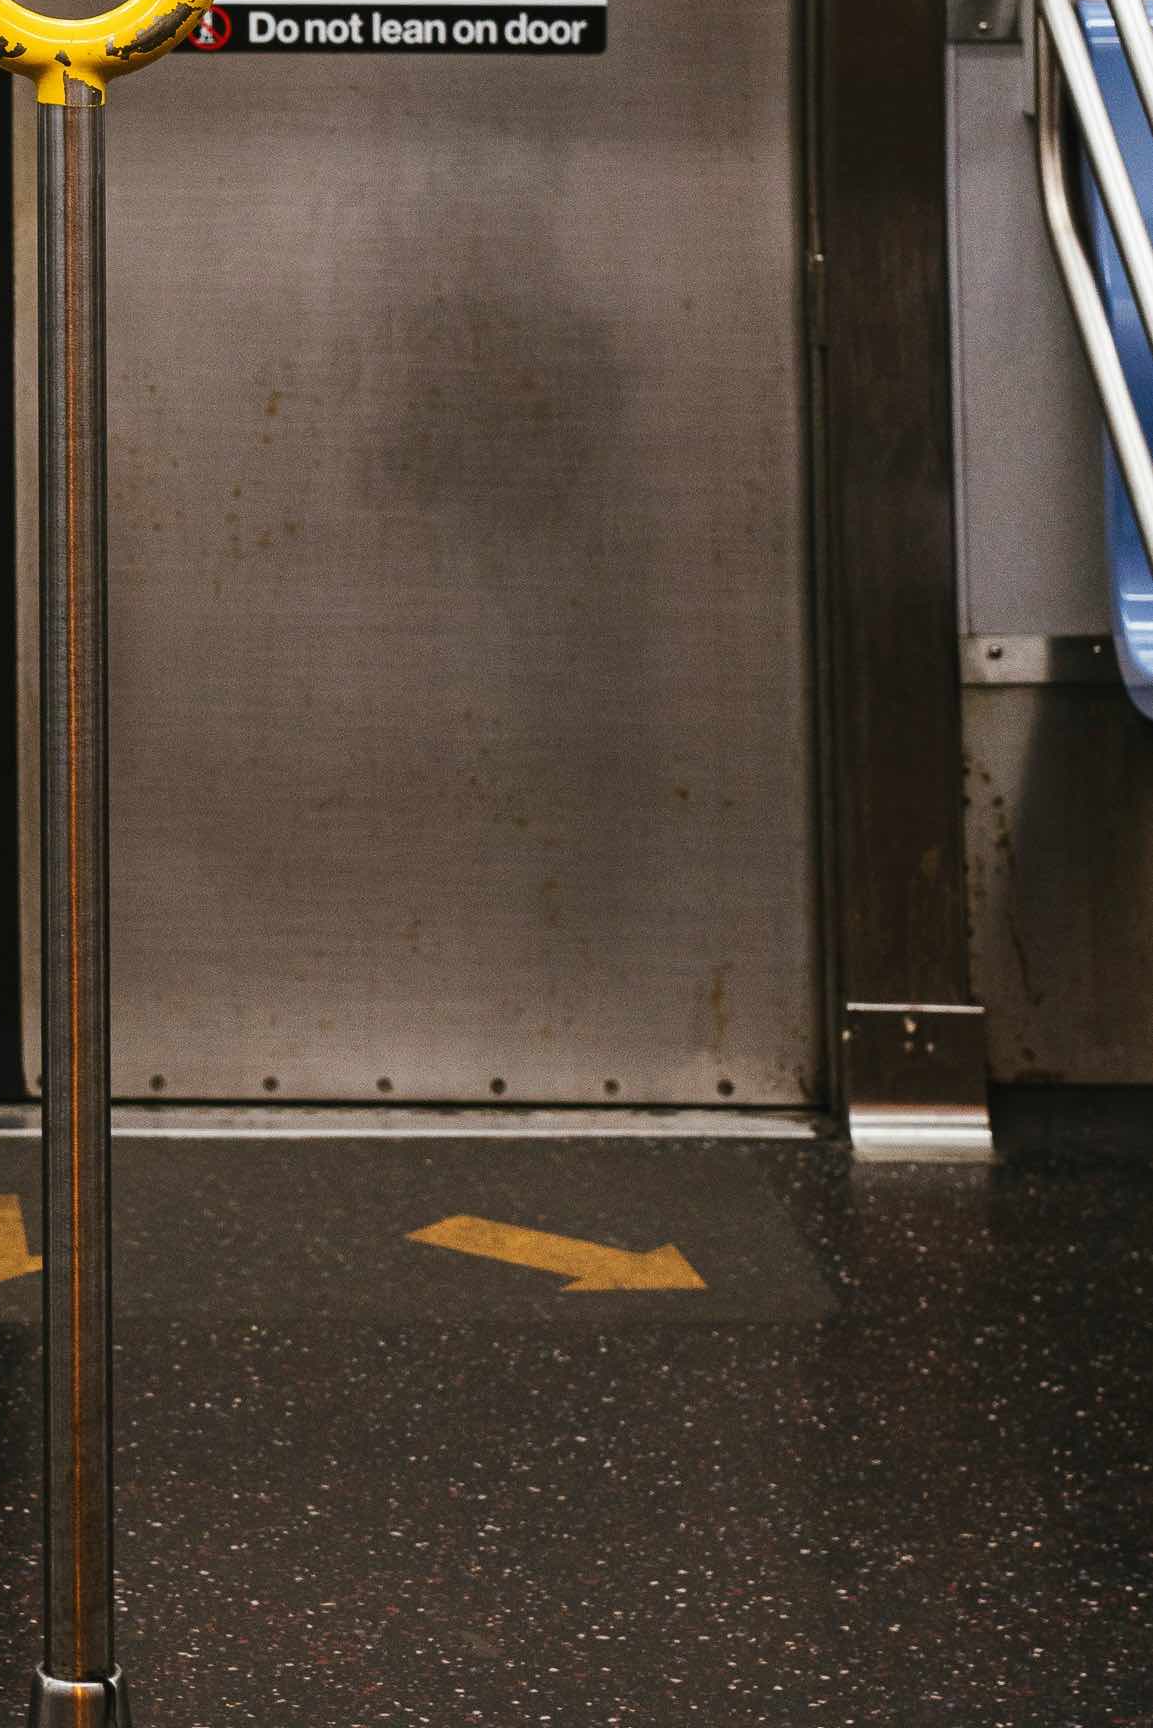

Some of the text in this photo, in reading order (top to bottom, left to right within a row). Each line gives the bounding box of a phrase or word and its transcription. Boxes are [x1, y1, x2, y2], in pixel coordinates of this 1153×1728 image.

[248, 11, 587, 45] Do not lean on door
